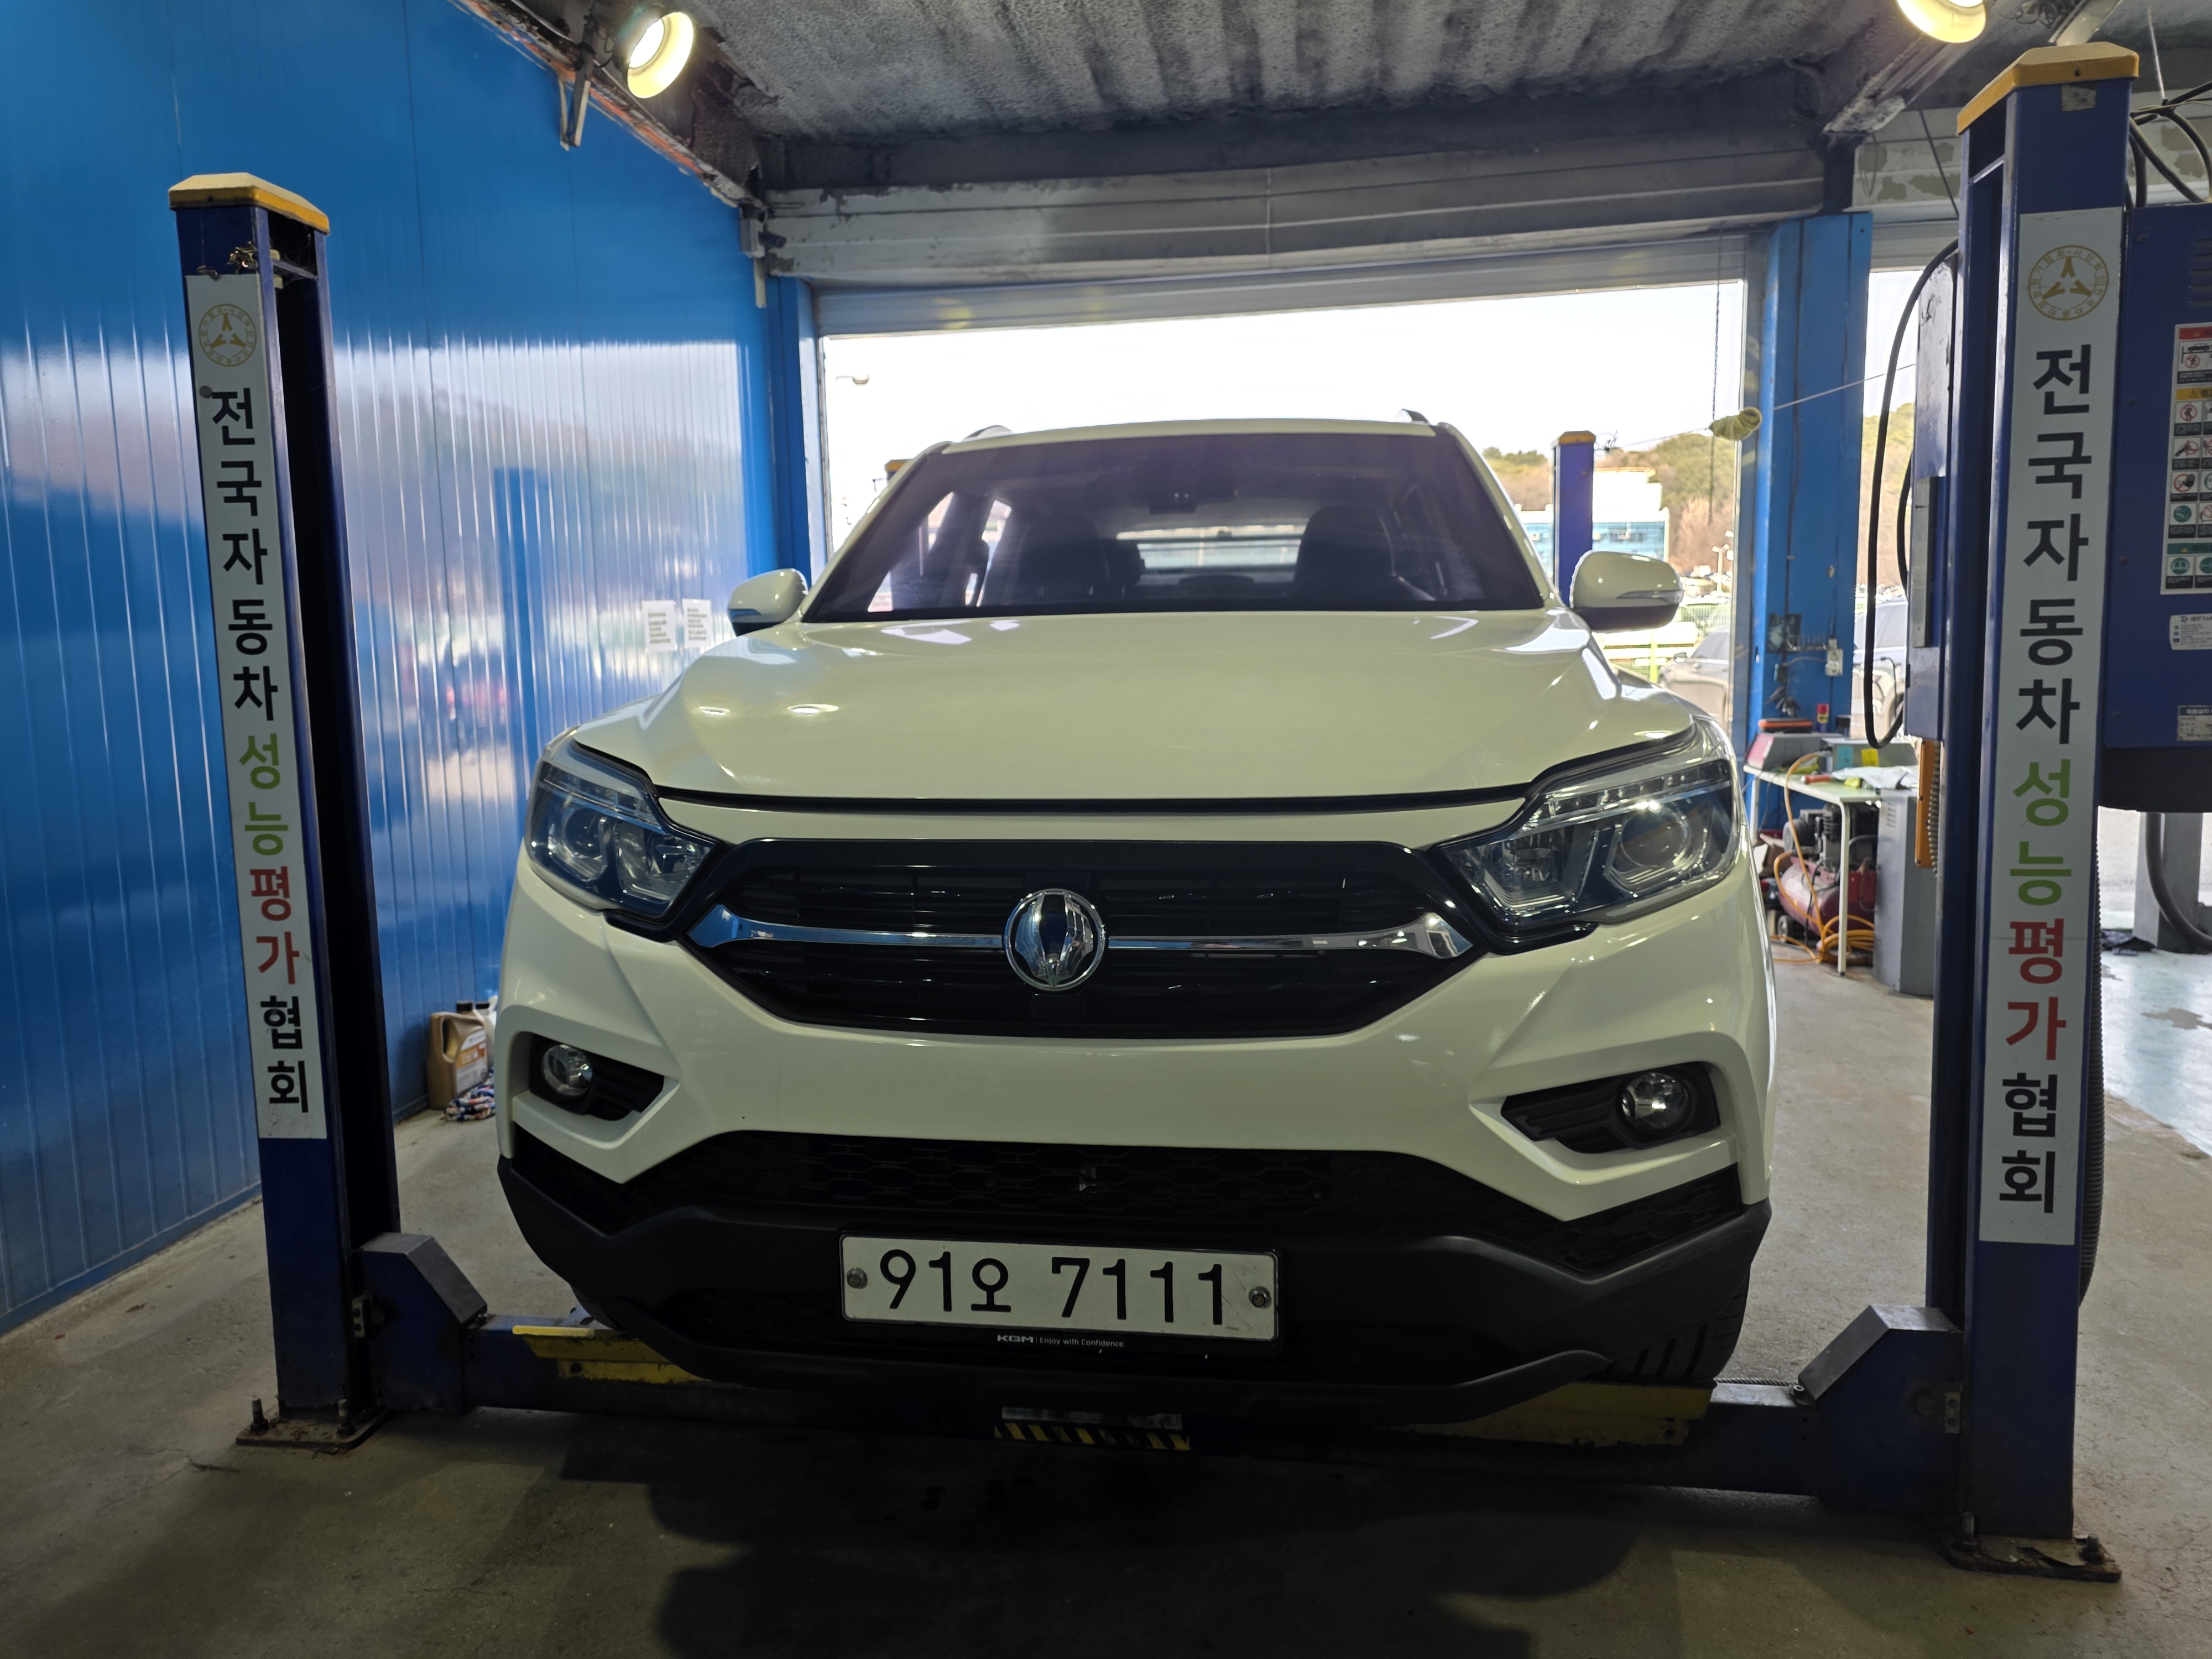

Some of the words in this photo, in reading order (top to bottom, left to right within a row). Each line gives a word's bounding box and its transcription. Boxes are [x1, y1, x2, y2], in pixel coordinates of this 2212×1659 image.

[880, 1249, 1011, 1313] 91오
[1051, 1256, 1223, 1326] 7111
[997, 1334, 1034, 1343] KGM
[1039, 1337, 1061, 1345] Enjoy
[1081, 1339, 1124, 1348] Confidence
